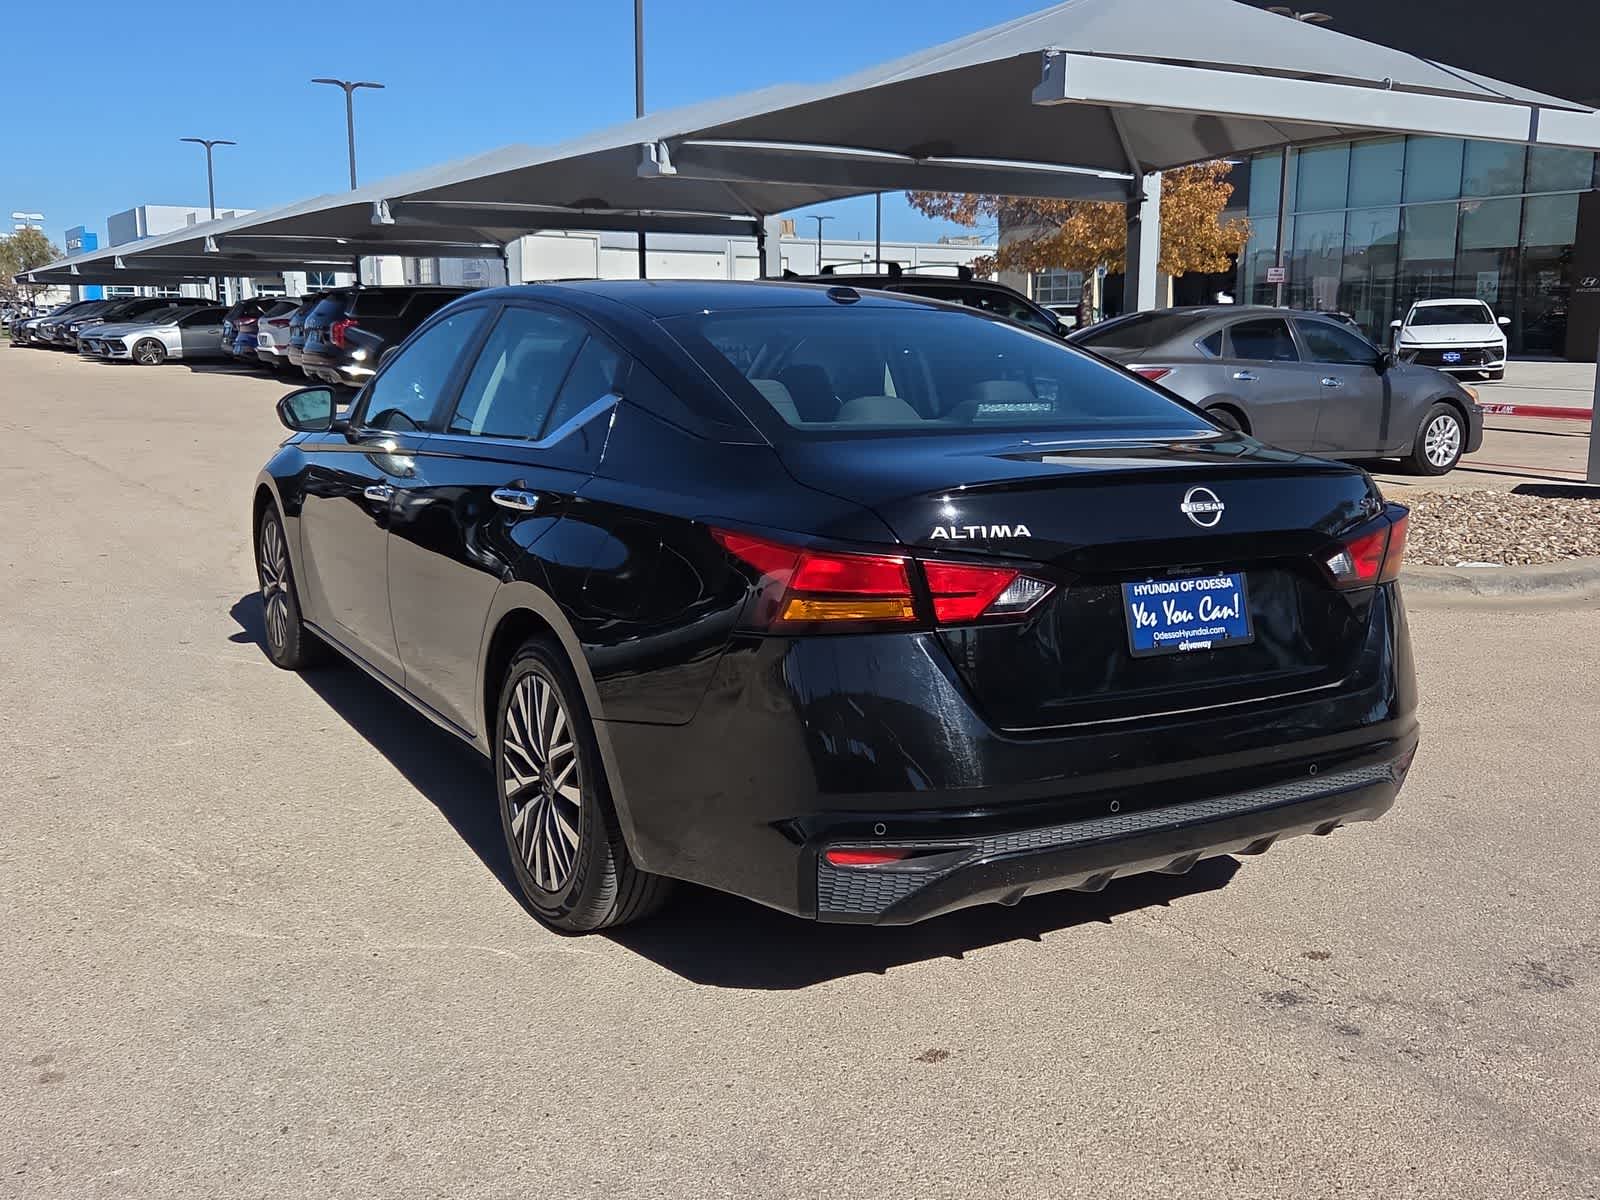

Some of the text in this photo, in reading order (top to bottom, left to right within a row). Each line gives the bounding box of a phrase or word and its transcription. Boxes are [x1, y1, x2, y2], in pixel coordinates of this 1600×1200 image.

[1182, 502, 1225, 512] NISSAN
[930, 525, 1032, 540] ALTIMA
[1134, 577, 1234, 596] HYUNDAI OF ODESSA
[1131, 593, 1239, 629] Yes You Can!
[1153, 626, 1226, 641] OdessaHyundai.com
[1178, 640, 1212, 651] driveway
